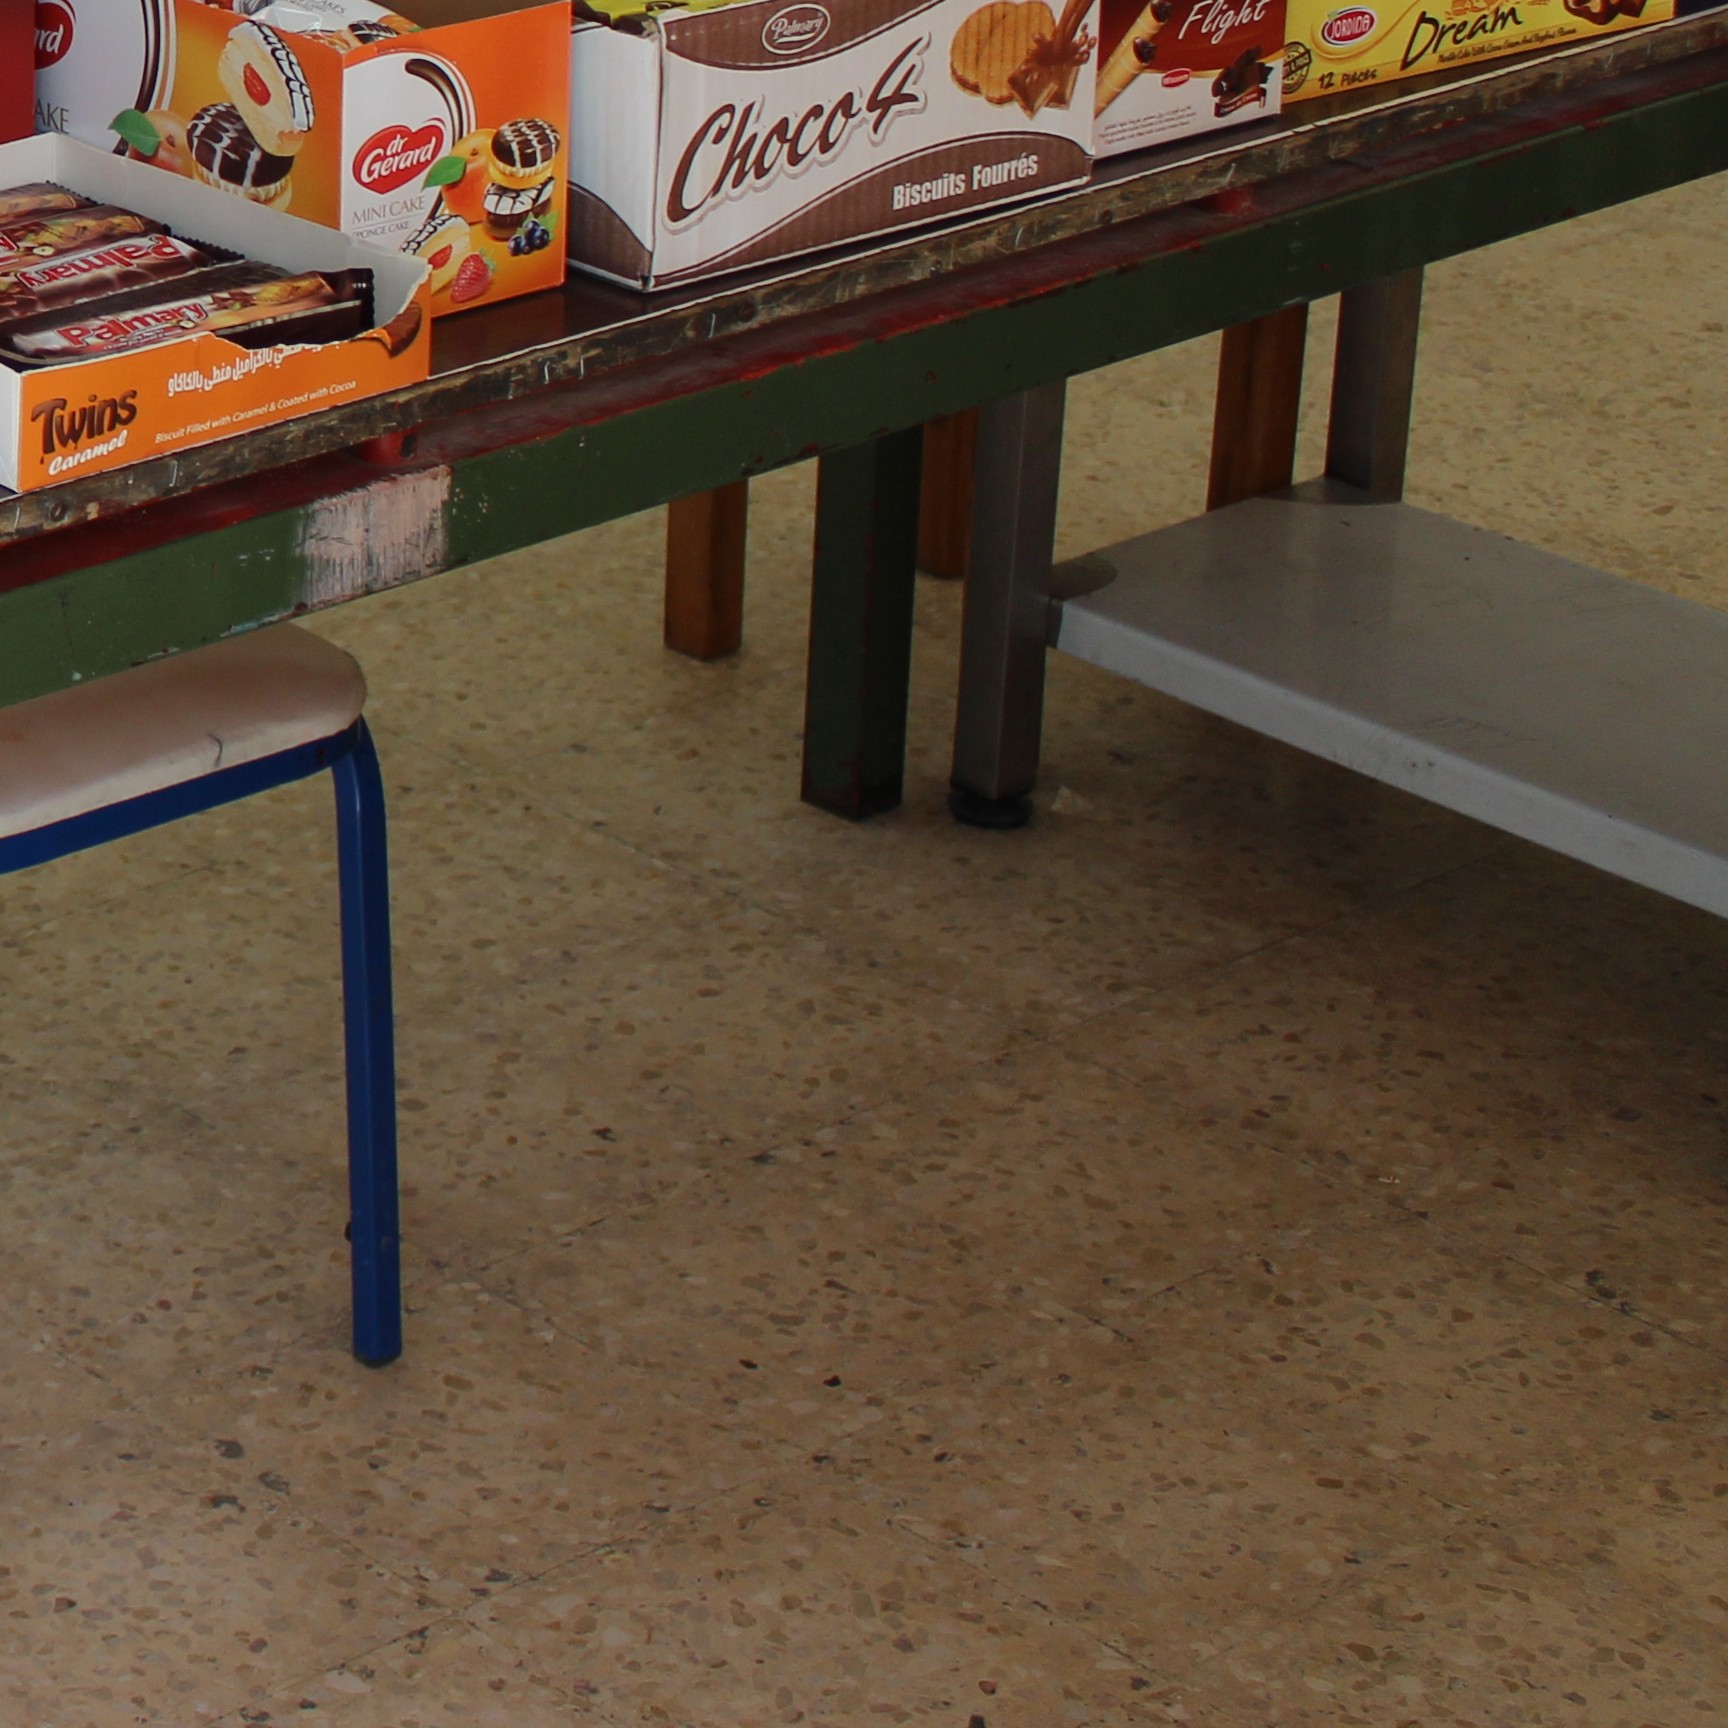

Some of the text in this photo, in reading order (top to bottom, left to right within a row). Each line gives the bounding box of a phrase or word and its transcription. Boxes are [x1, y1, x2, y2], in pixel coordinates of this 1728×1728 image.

[771, 15, 822, 42] Palmary
[1401, 6, 1522, 71] Dream
[1319, 72, 1333, 89] 12
[387, 134, 406, 157] dr
[668, 36, 925, 225] Choco 4
[361, 139, 440, 183] Gerard
[892, 152, 1037, 209] Biscuits Fourrés
[353, 197, 426, 224] MINI CAKE
[384, 221, 410, 232] CAKE
[19, 235, 181, 289] Palmary
[58, 302, 207, 347] Palmary
[32, 389, 138, 456] Twins
[155, 429, 184, 444] Biscuit
[186, 423, 208, 439] Filled
[209, 418, 231, 434] with
[232, 405, 268, 424] Caramel
[277, 395, 308, 412] Coated
[310, 390, 328, 405] with
[329, 380, 357, 398] Cocoa
[48, 430, 128, 476] Caramel
